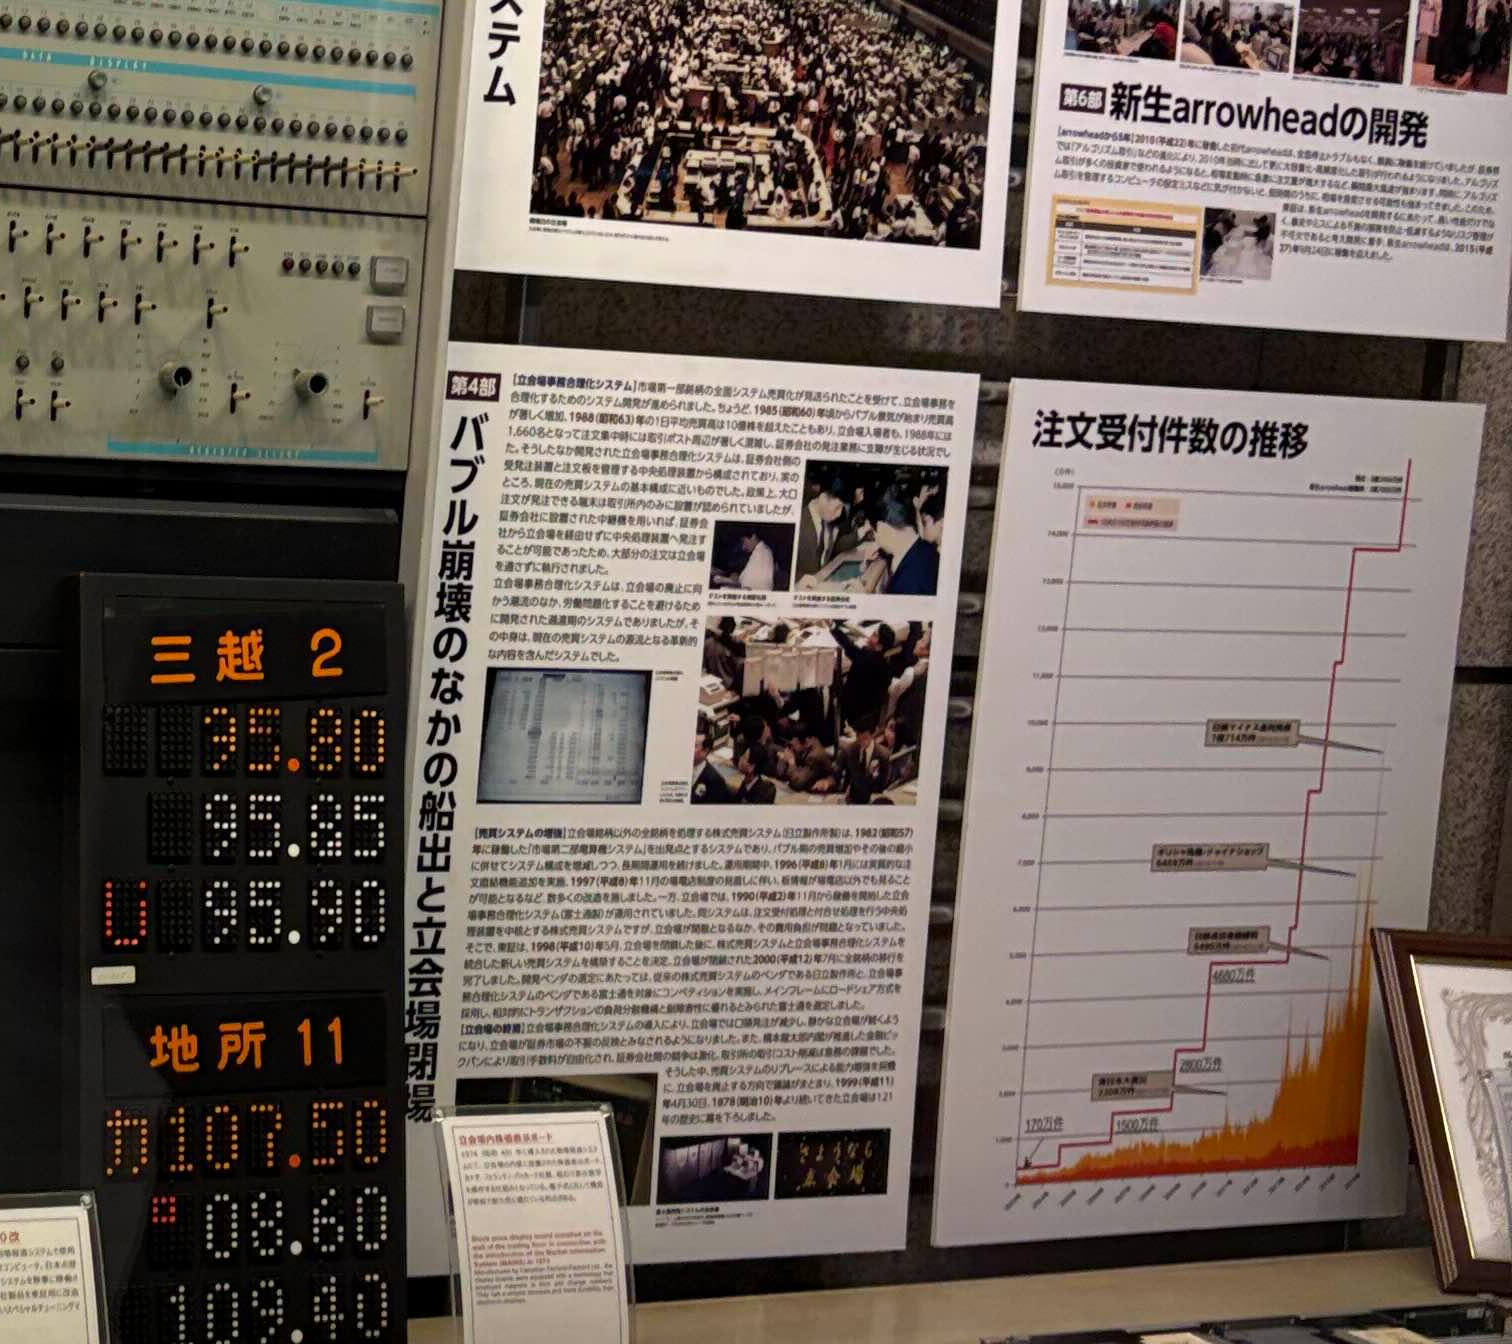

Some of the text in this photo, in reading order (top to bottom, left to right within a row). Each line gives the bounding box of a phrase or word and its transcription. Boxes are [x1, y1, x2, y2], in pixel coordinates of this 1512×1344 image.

[1109, 81, 1430, 149] 新生arrowheadの開発
[449, 375, 497, 398] 第4部
[1031, 409, 1309, 459] 注文受付件数の推移
[150, 627, 344, 684] 三越 2
[405, 411, 490, 1123] バブル崩壊のなかの船出と立会場閉場
[149, 1017, 344, 1073] 地所 11
